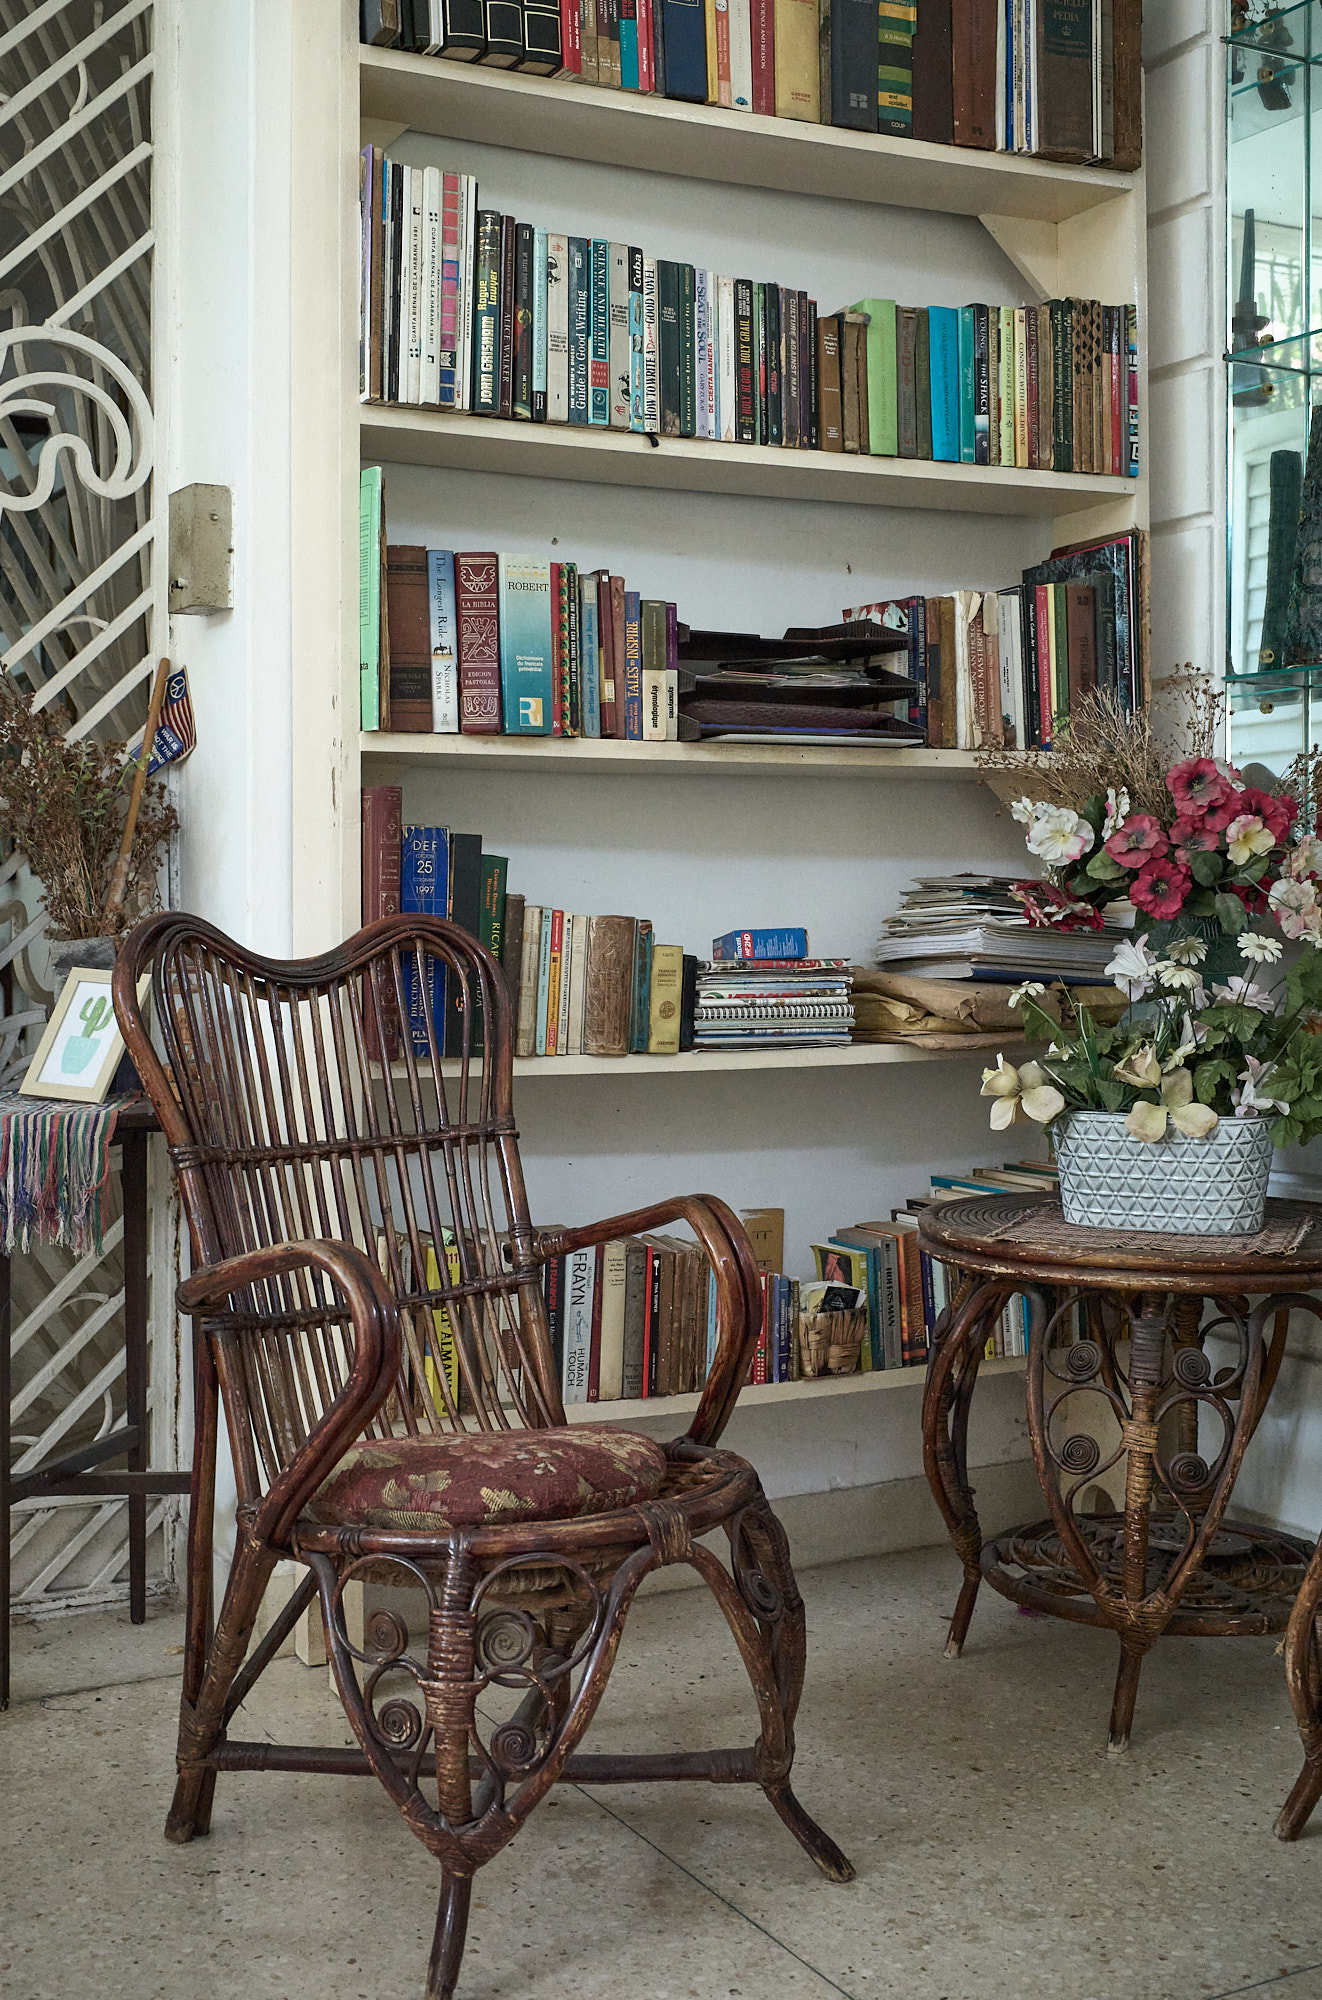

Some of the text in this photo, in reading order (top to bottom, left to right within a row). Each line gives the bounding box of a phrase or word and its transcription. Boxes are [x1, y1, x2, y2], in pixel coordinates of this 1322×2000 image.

[412, 272, 418, 280] LA
[429, 279, 435, 290] DE
[633, 254, 642, 287] Cuba
[644, 268, 655, 297] NOVEL
[412, 281, 418, 290] DE
[429, 290, 435, 298] LA
[477, 280, 488, 310] Rogue
[487, 269, 498, 305] Lawyer
[536, 282, 544, 294] OF
[597, 244, 606, 356] SCIENCE AND HEALTH
[697, 286, 706, 314] SEAT
[536, 295, 544, 324] TRAUMA
[644, 299, 655, 324] GOOD
[789, 298, 797, 337] CULTURE
[979, 316, 988, 348] YOUNG
[1029, 310, 1037, 340] SECRET
[480, 316, 494, 403] JOHN GRISHAM
[502, 311, 511, 382] ALICE WALKER
[536, 326, 544, 367] RELATIONAL
[576, 290, 588, 409] Guide to Good Writing
[697, 331, 707, 364] SOUL
[536, 368, 544, 380] THE
[645, 357, 657, 385] WRITE
[739, 319, 752, 415] HOLY BLOOD, HOLY GRAIL
[645, 386, 657, 396] TO
[980, 379, 989, 413] SHACK
[645, 399, 657, 421] HOW
[709, 403, 714, 414] DE
[434, 555, 448, 639] The Longest Ride
[507, 581, 549, 592] ROBERT
[569, 613, 577, 630] PROUST
[626, 621, 639, 659] INSPIRE
[465, 678, 496, 686] PASTORAL
[627, 666, 639, 697] TALES
[651, 685, 660, 728] étymologique
[667, 686, 675, 719] synonymes
[977, 682, 986, 732] OF WORLD
[161, 728, 179, 751] WAR IS
[161, 745, 173, 759] THE
[412, 840, 438, 851] DEF
[416, 860, 433, 874] 25
[492, 868, 500, 891] CARMEN
[416, 886, 435, 894] 1997
[735, 937, 743, 959] maxell
[743, 933, 751, 957] MF2HD
[547, 1027, 555, 1047] POCKET
[549, 1268, 558, 1310] RANKIN
[571, 1252, 588, 1306] FRAYN
[886, 1267, 896, 1327] HOFFA'S MAN
[911, 1294, 926, 1342] ERSKINE
[567, 1350, 577, 1386] TOUCH
[576, 1348, 586, 1387] HUMAN
